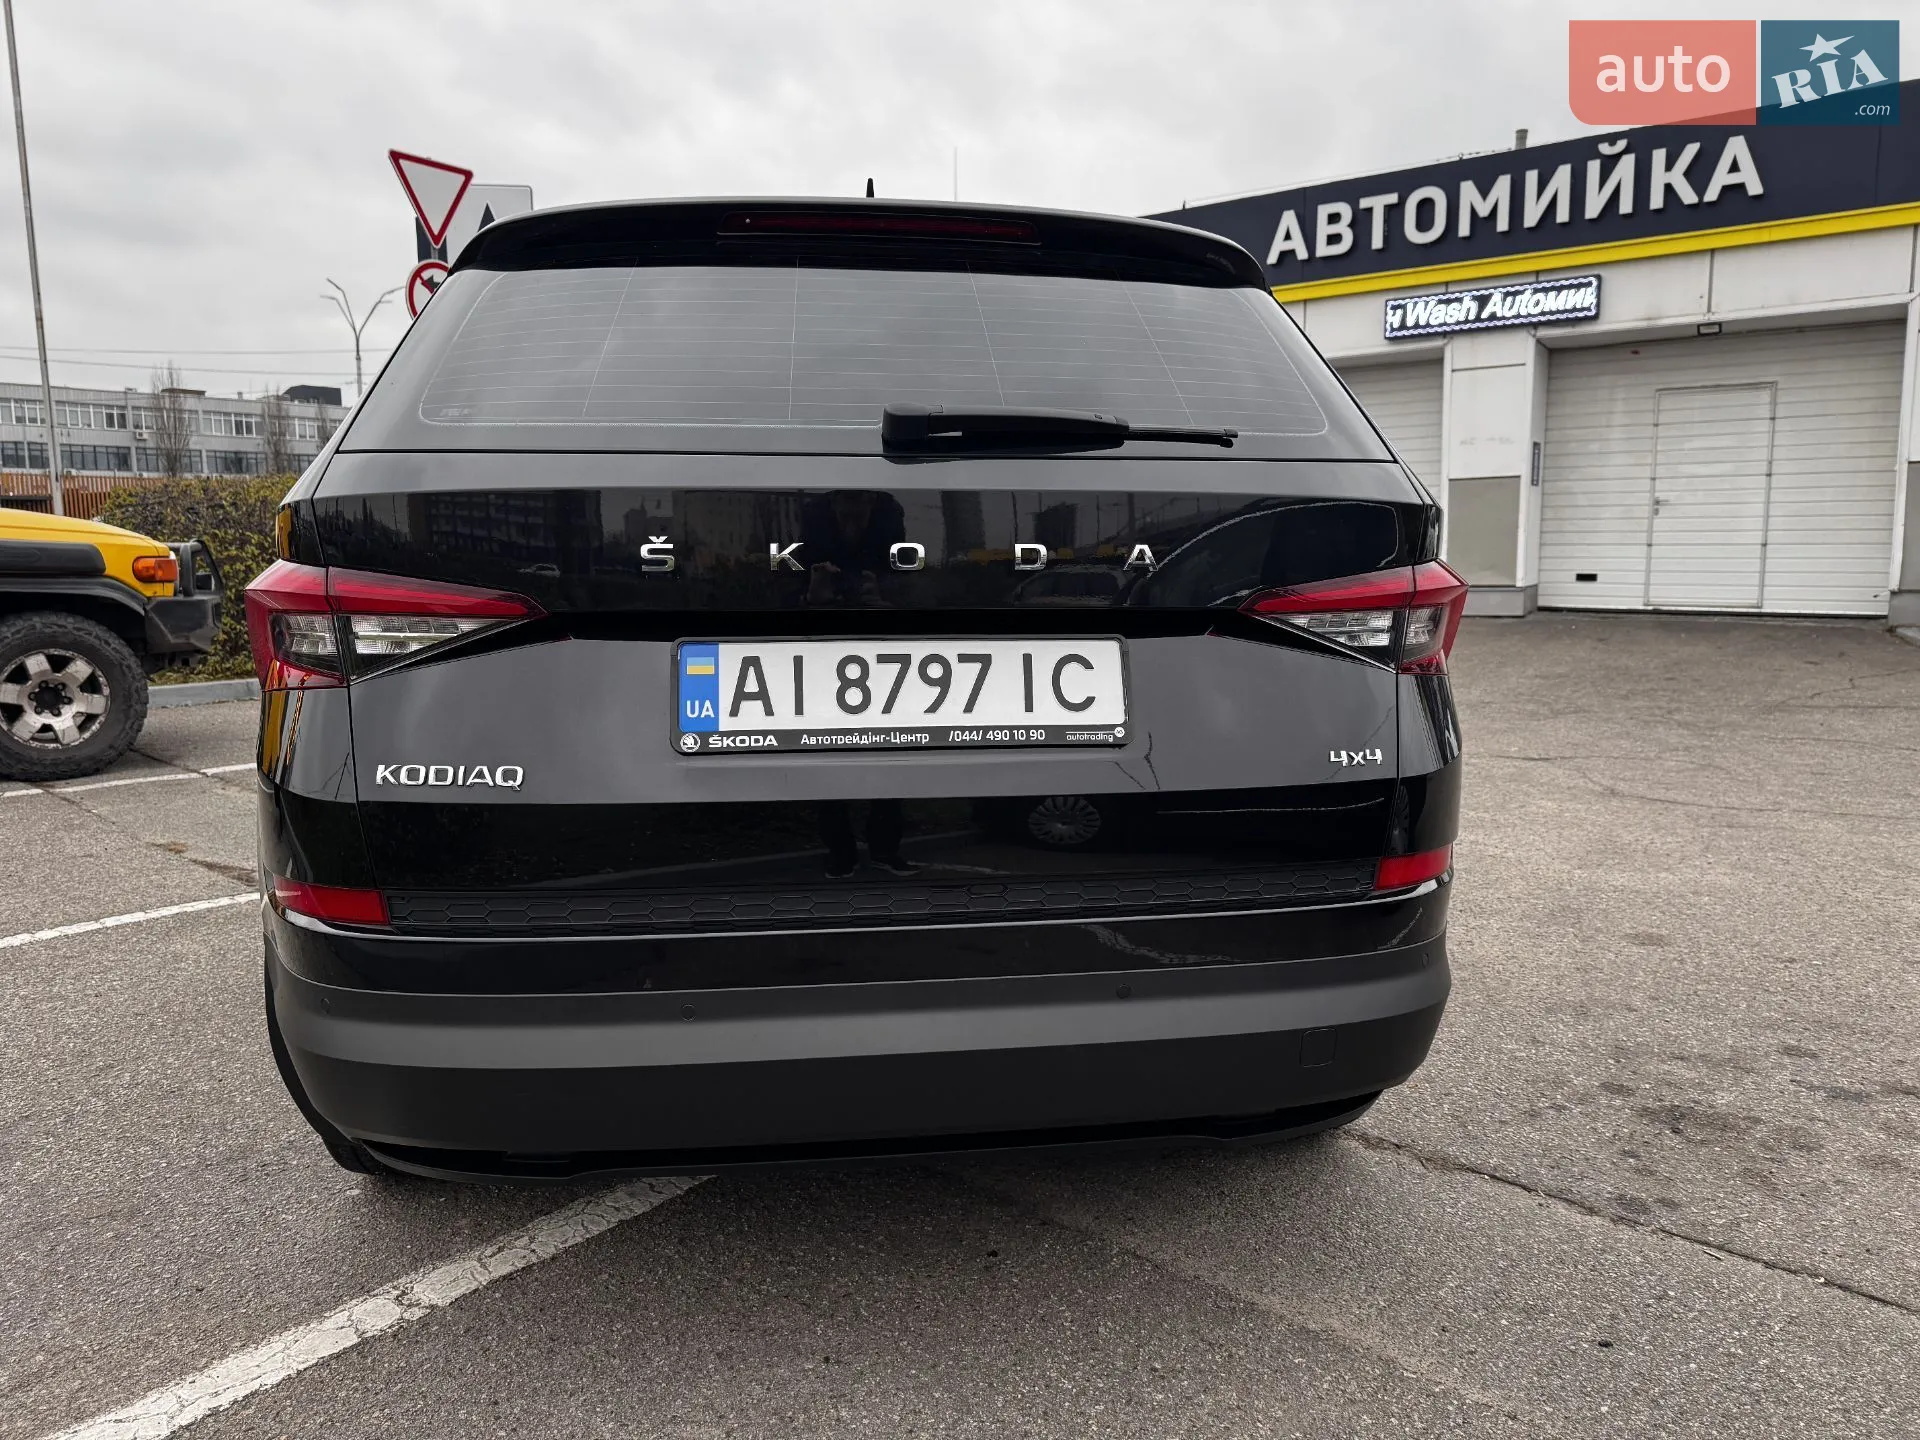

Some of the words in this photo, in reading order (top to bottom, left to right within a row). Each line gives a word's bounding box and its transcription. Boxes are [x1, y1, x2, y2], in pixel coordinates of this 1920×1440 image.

[1266, 135, 1764, 266] АВТОМИЙКА
[1405, 295, 1478, 328] Wash
[640, 536, 1158, 573] ŠKODA
[729, 655, 803, 717] AI
[836, 653, 992, 714] 8797
[1022, 653, 1096, 713] IC
[686, 700, 715, 718] UA
[708, 734, 778, 748] ŠKODA
[800, 731, 930, 745] Автотрейдінг-Центр
[949, 730, 983, 742] /044/
[986, 730, 1009, 741] 490
[1013, 730, 1026, 741] 10
[1030, 730, 1046, 741] 90
[1066, 732, 1114, 743] autotrading
[1329, 748, 1383, 767] 4x4
[376, 764, 524, 791] KODIAQ
